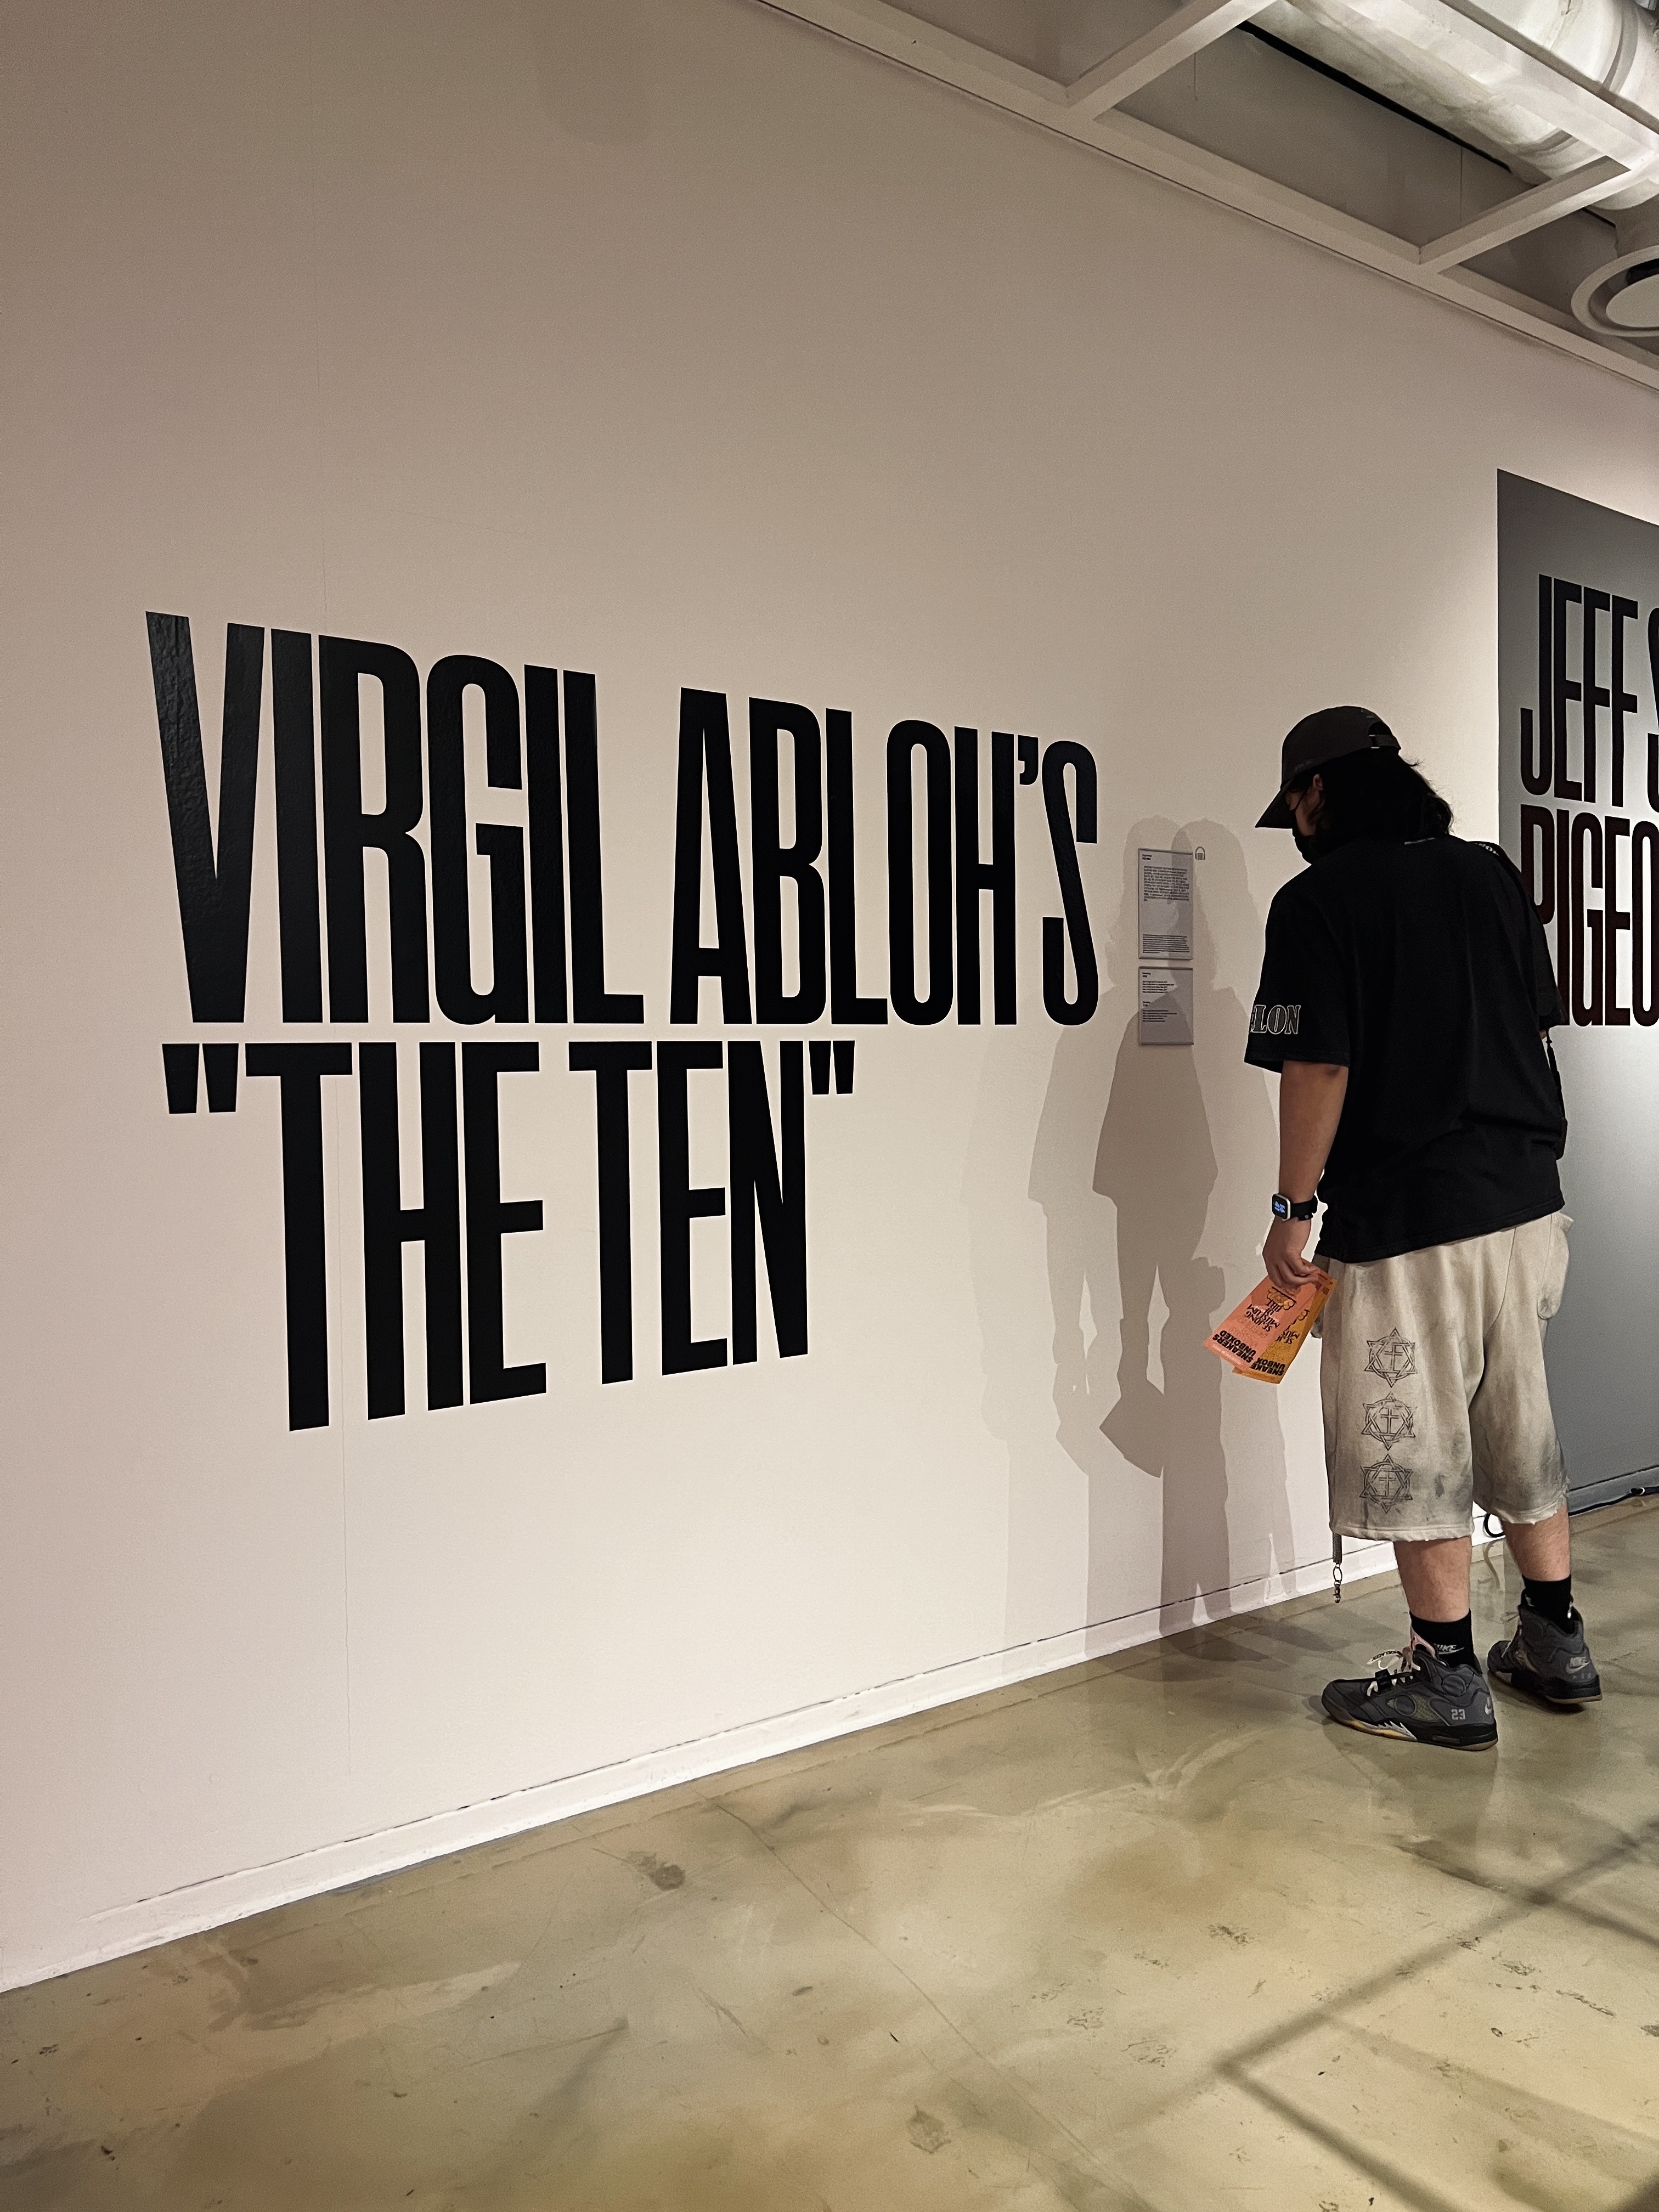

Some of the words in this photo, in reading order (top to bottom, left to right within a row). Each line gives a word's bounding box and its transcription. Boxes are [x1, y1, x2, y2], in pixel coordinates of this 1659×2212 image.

[1520, 574, 1638, 808] JEFF
[145, 611, 644, 1023] VIRGIL
[670, 687, 1098, 1025] ABLOH'S
[1250, 1005, 1301, 1035] LON
[161, 1041, 547, 1431] "THE
[569, 1040, 855, 1384] TEN"
[1245, 1311, 1273, 1332] SEJONG
[1246, 1304, 1279, 1328] MUSEUM
[1212, 1334, 1254, 1363] SNEAKERS
[1219, 1329, 1256, 1356] UNBOXED
[1451, 1708, 1466, 1720] 23
